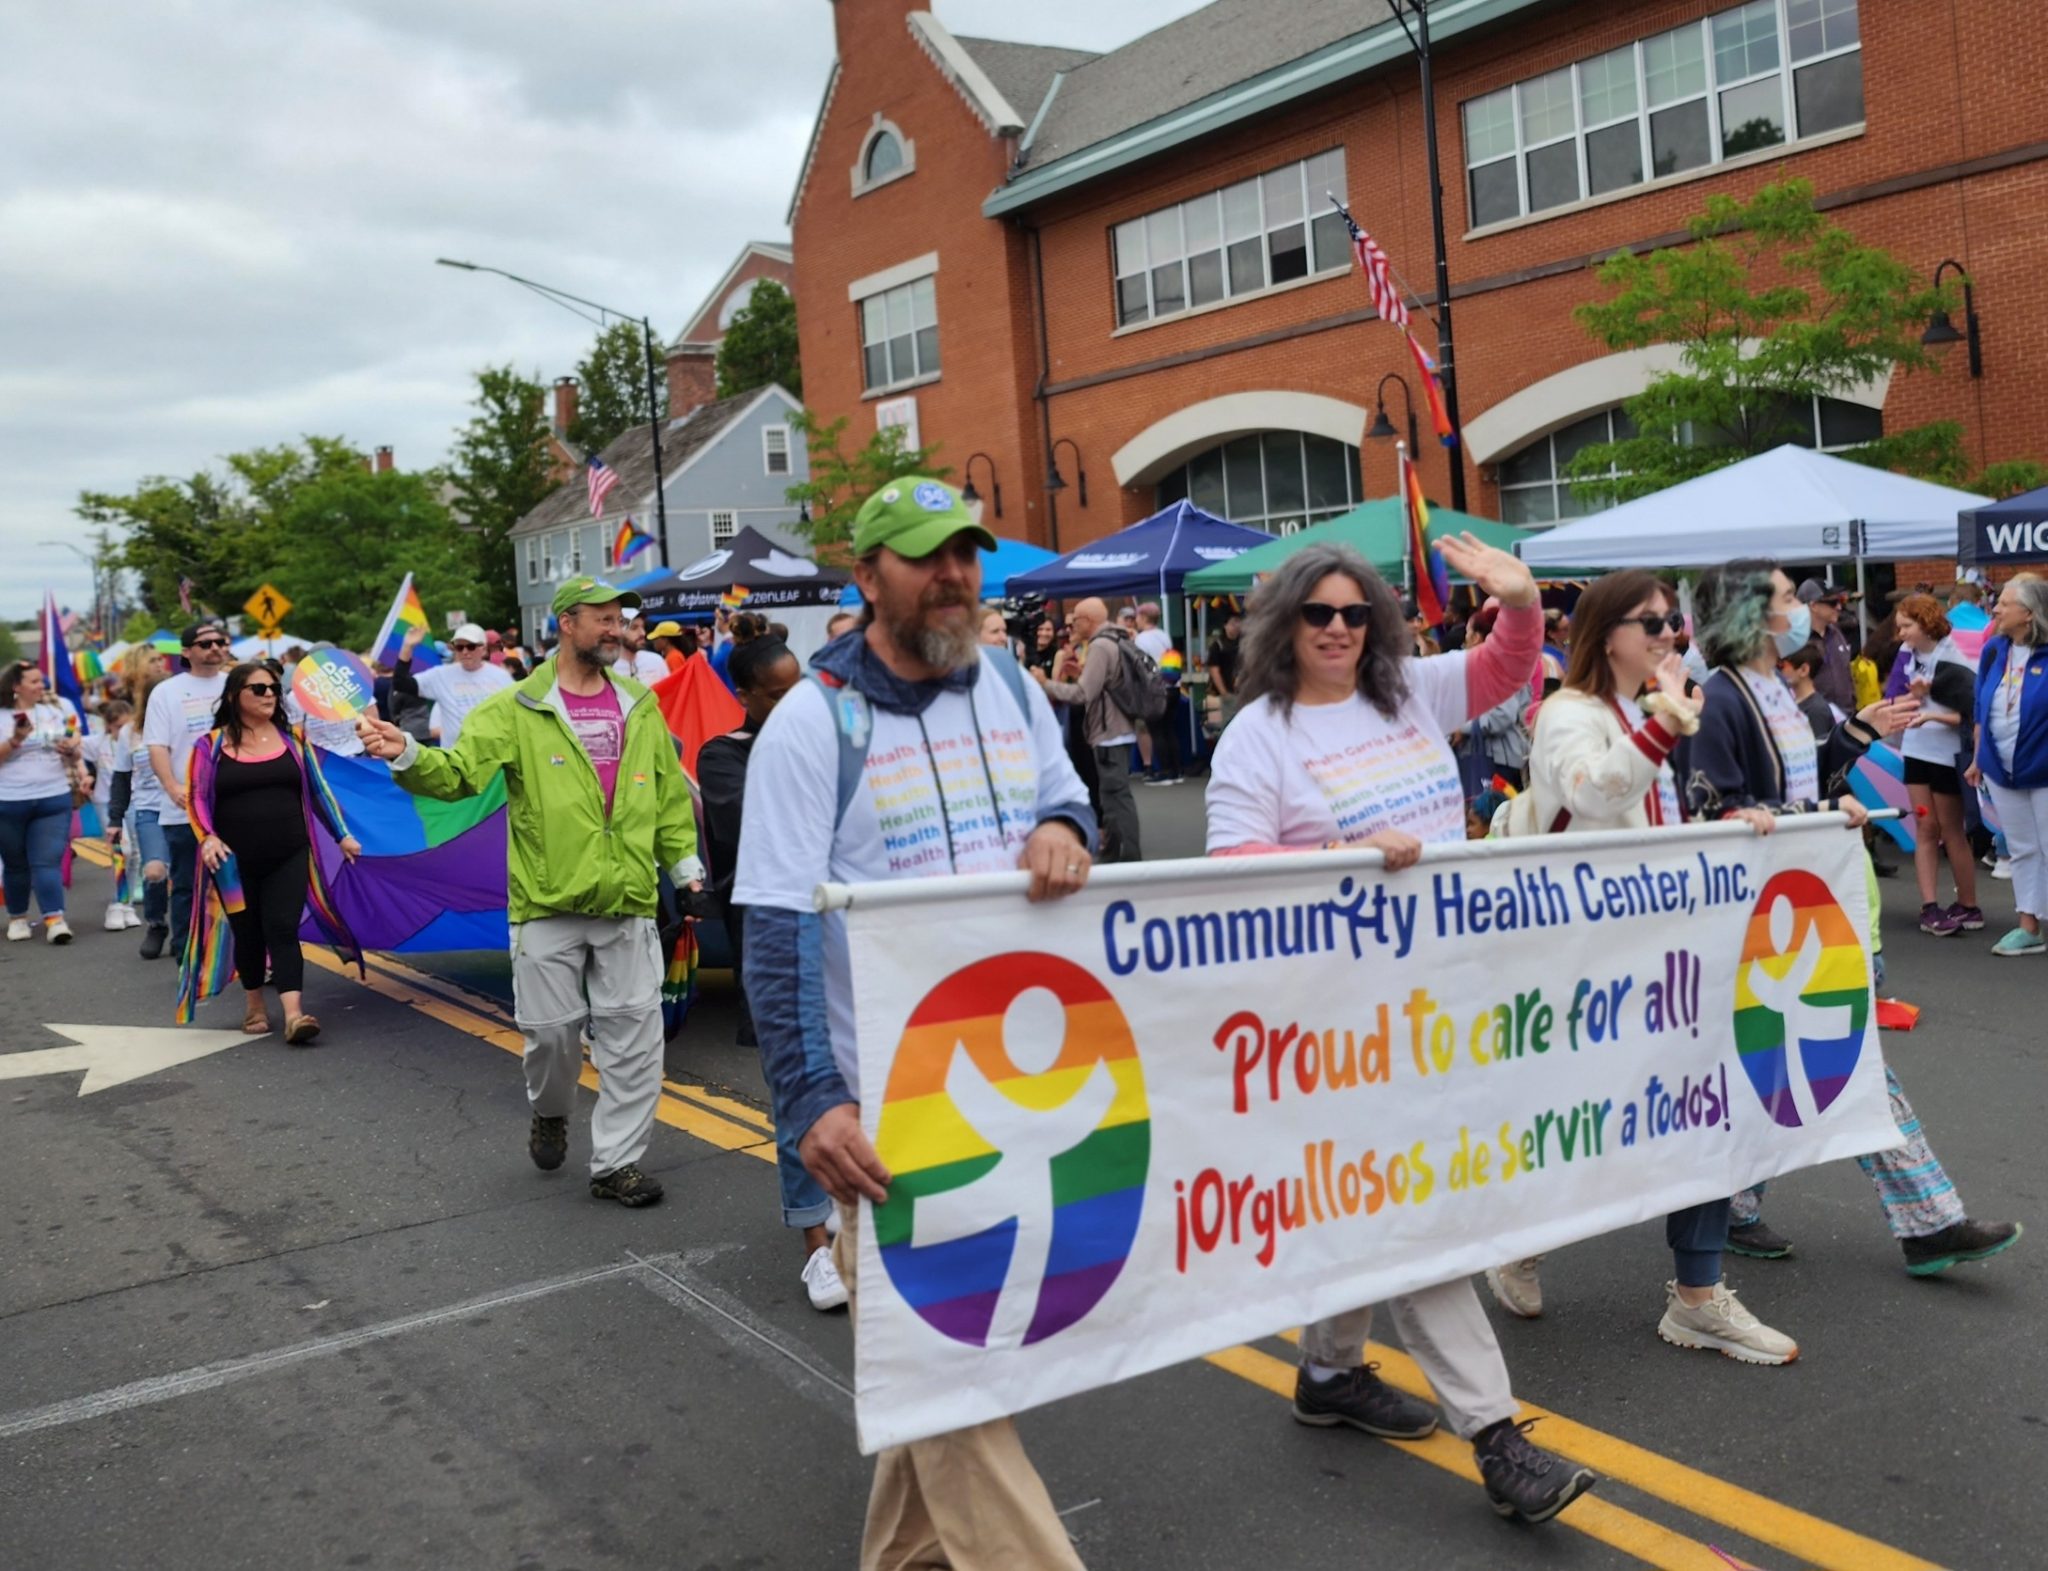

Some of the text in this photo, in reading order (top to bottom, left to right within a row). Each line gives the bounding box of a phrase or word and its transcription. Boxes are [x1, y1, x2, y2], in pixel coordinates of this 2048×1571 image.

[866, 744, 916, 769] Health
[1331, 787, 1375, 815] Health
[1376, 781, 1402, 796] Care
[1337, 800, 1384, 831] Health
[1385, 794, 1412, 811] Care
[880, 806, 936, 832] Health
[885, 826, 941, 851] Health
[949, 819, 979, 835] Care
[1344, 818, 1390, 845] Health
[1392, 810, 1417, 827] Care
[890, 847, 945, 872] Health
[953, 841, 985, 856] Care
[1103, 851, 1757, 977] Community Health Center, Inc.
[1212, 949, 1701, 1115] Proud to care for all!
[1174, 1139, 1435, 1274] ¡Orgullosos
[1447, 1125, 1491, 1192] de
[1620, 1101, 1639, 1147] a
[1645, 1062, 1731, 1140] todos!
